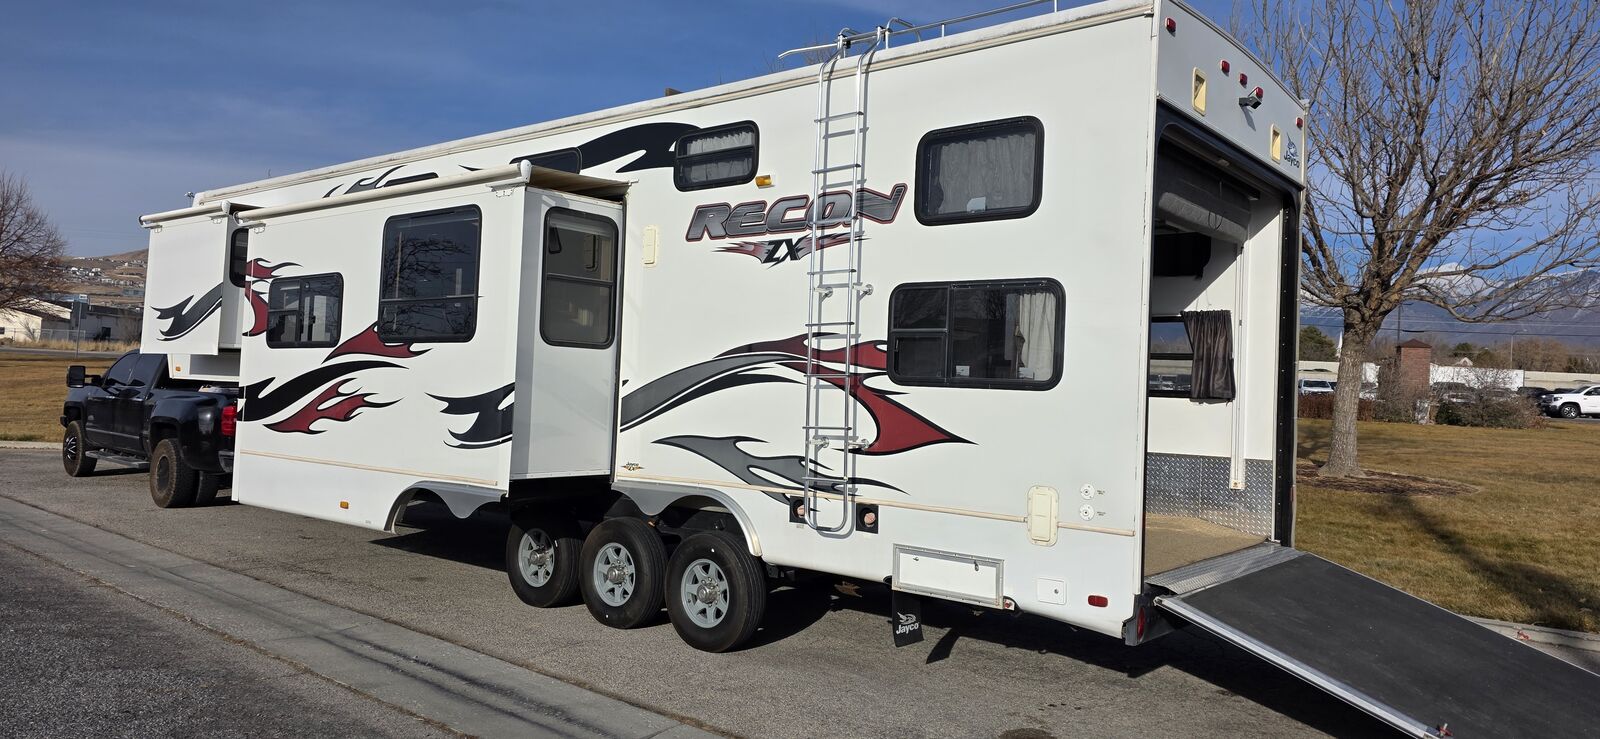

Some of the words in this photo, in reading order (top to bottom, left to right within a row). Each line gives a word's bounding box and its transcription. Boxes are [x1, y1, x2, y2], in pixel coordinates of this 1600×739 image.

[1284, 150, 1300, 168] Jayco
[686, 183, 908, 242] RECON
[762, 237, 804, 269] ZX
[896, 622, 919, 634] Jayco
